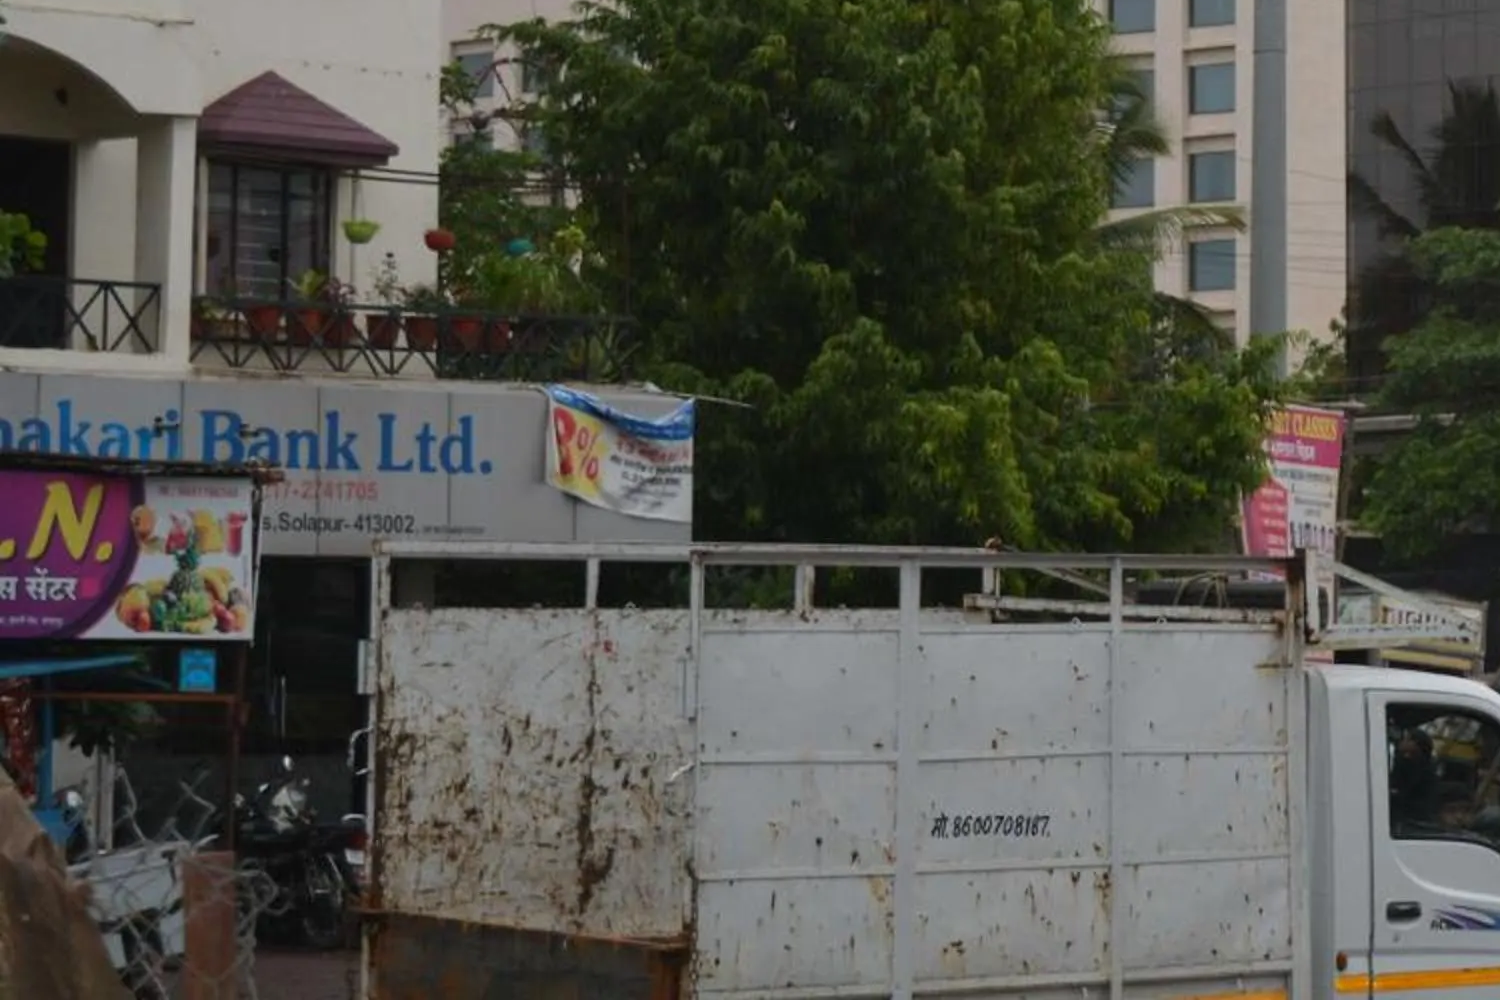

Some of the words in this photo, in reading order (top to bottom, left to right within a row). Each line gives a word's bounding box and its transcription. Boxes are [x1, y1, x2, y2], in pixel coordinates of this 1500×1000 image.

[199, 410, 361, 472] Bank
[377, 412, 494, 476] Ltd.
[25, 567, 77, 601] सेंटर
